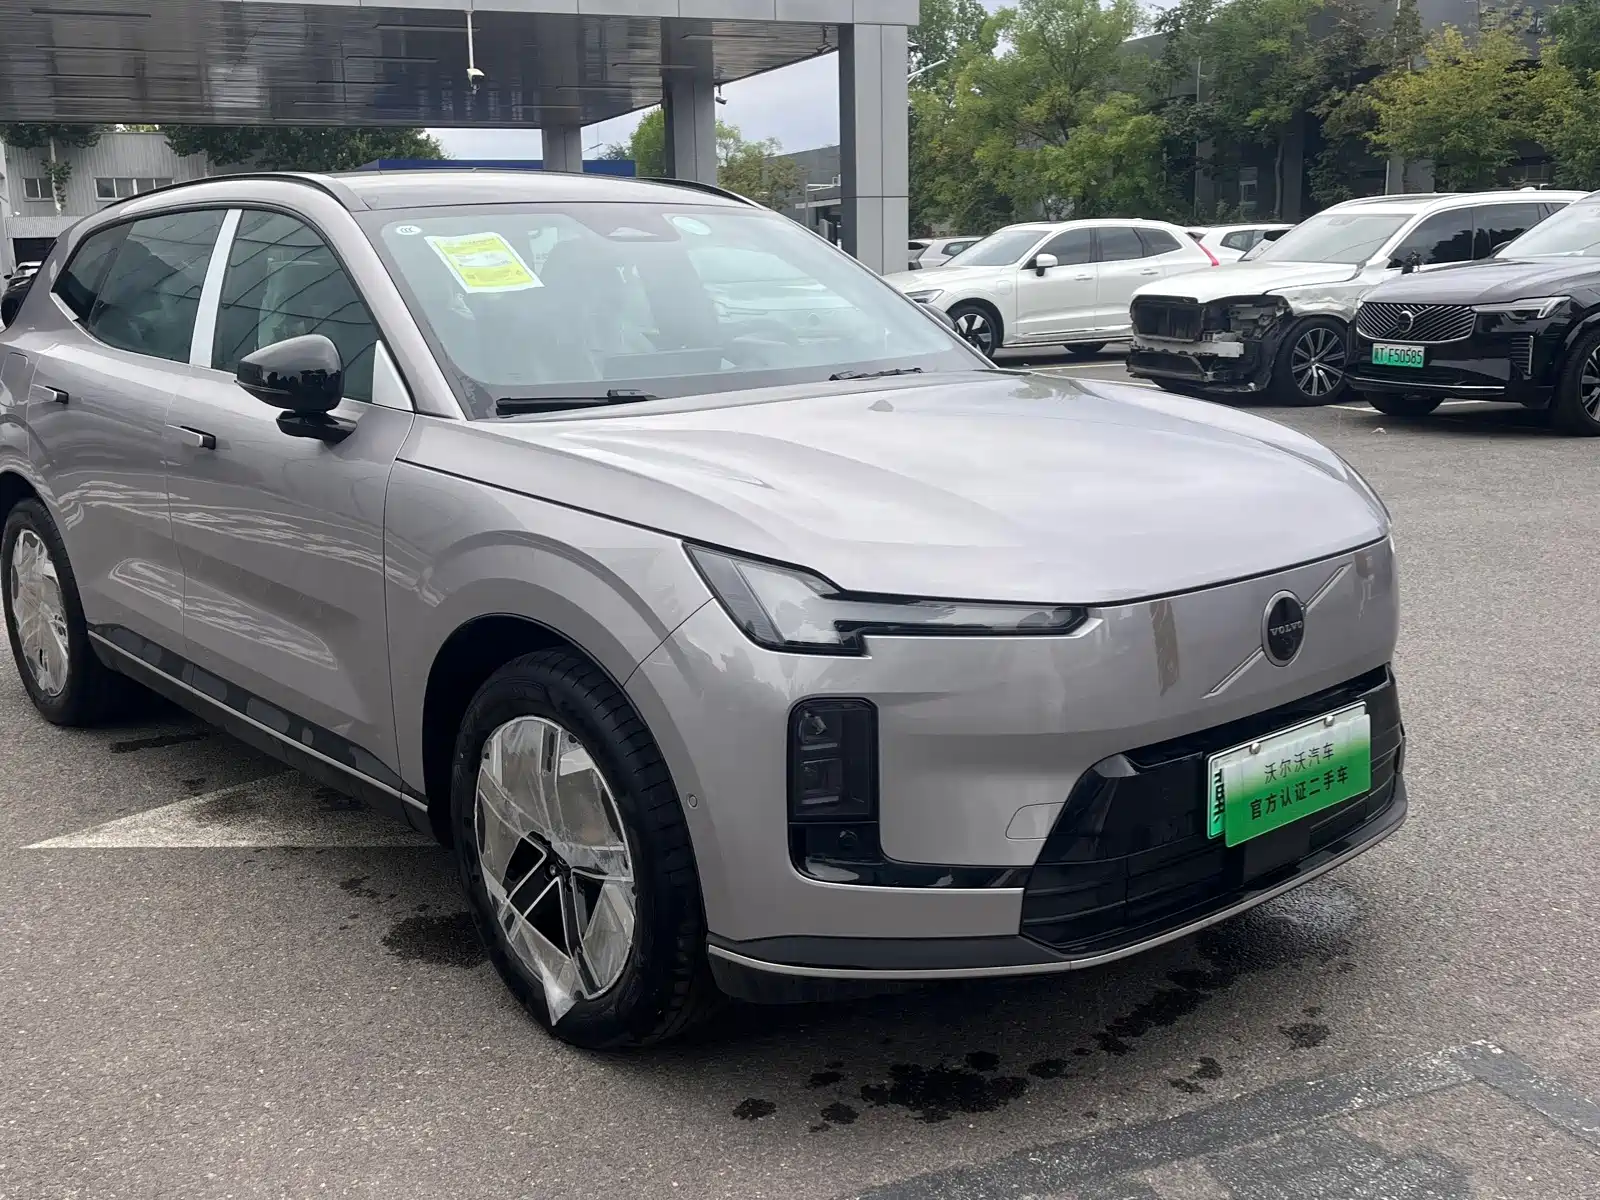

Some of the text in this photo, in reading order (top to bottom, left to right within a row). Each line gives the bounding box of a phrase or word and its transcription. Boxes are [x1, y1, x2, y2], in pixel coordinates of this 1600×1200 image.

[1269, 620, 1303, 636] VOLVO
[1264, 742, 1335, 784] 沃尔沃汽车
[1250, 764, 1349, 820] 官方认证二手车
